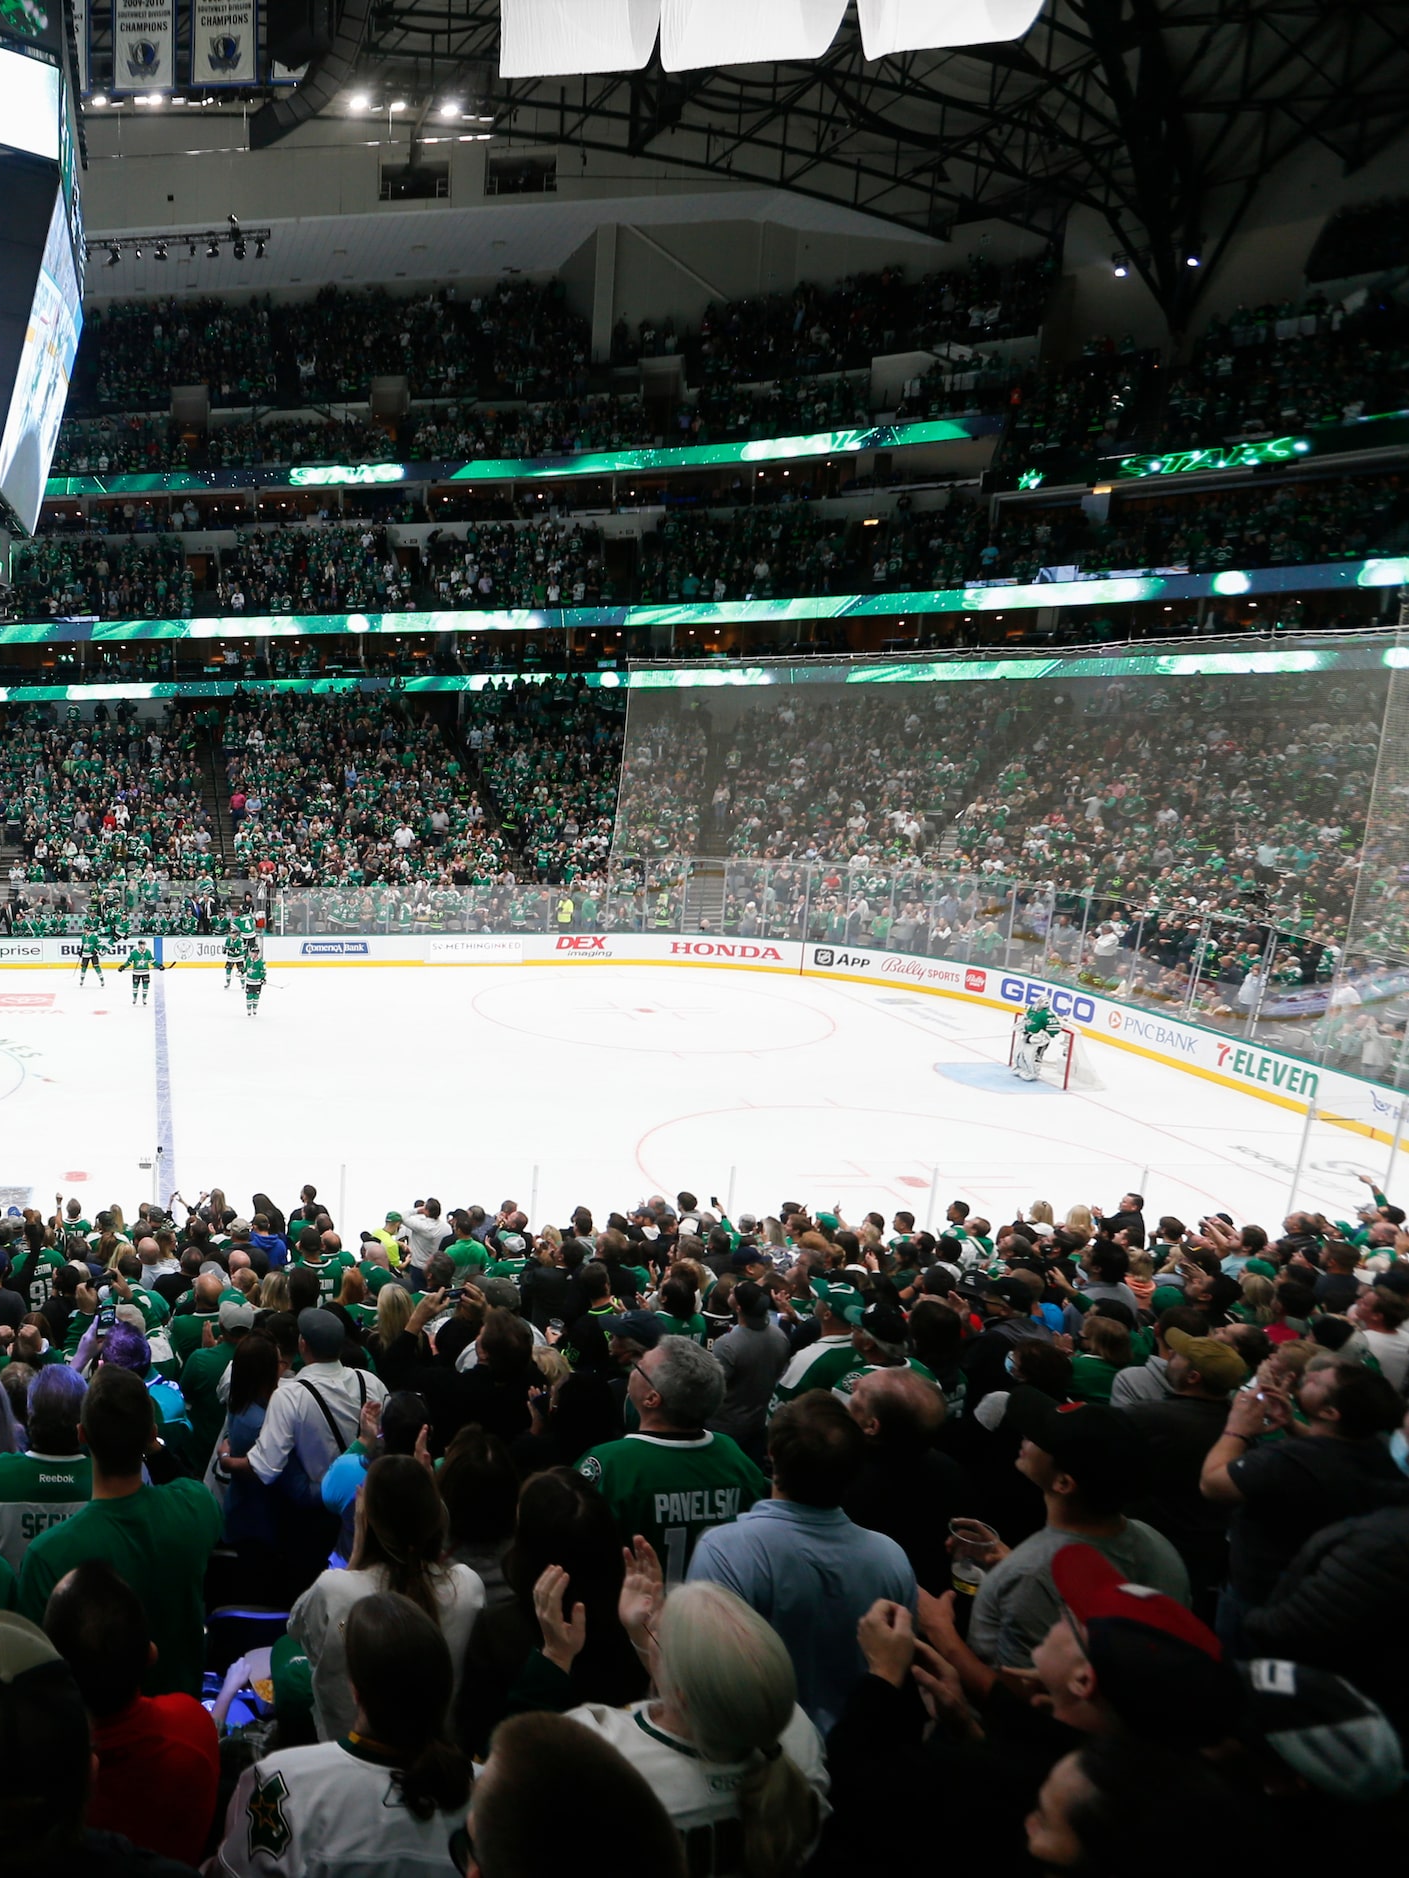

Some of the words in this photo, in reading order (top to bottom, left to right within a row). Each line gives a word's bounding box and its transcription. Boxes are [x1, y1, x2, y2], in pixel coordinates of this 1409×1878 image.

[201, 13, 249, 26] CHAMPIONS
[120, 21, 168, 32] CHAMPIONS
[344, 943, 365, 953] Bank
[555, 936, 609, 949] DEX
[567, 950, 614, 958] imaging
[670, 941, 784, 961] HONDA
[881, 957, 926, 980] Bally
[927, 969, 960, 983] SPORTS
[1001, 978, 1095, 1023] GEICO
[38, 1473, 75, 1483] Reebok
[654, 1487, 741, 1524] PAVELSKI
